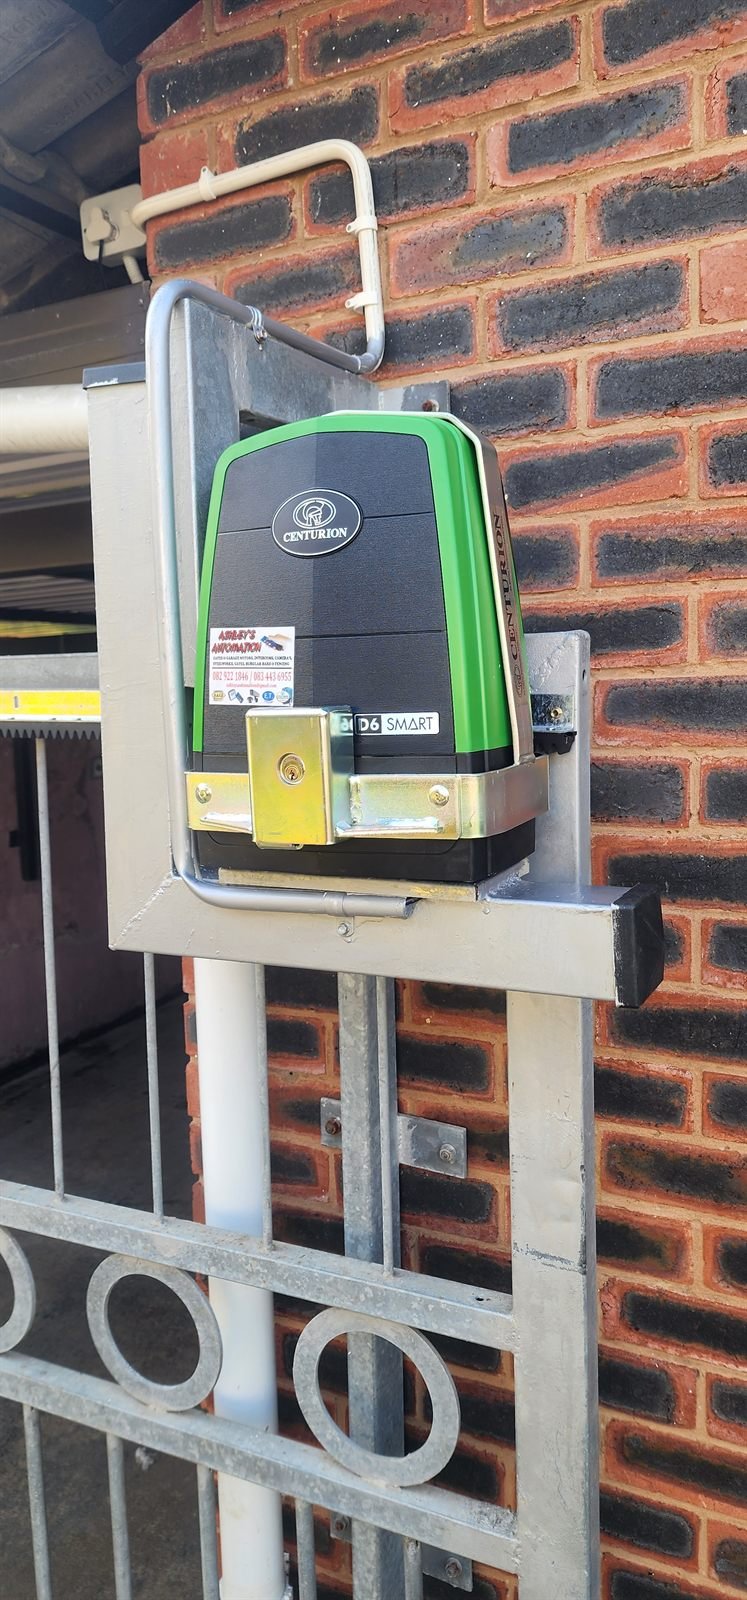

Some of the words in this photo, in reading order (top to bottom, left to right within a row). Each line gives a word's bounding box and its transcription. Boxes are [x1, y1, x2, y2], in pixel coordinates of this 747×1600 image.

[283, 527, 347, 542] CENTURION
[494, 513, 518, 660] CENTURION
[218, 630, 256, 640] ASHLEY'S
[212, 642, 262, 654] AUTOMATION
[212, 671, 222, 680] 082
[224, 671, 234, 681] 922
[235, 671, 248, 681] 1846
[254, 672, 264, 681] 083
[265, 672, 276, 681] 443
[277, 672, 292, 682] 6955
[359, 718, 380, 731] D6
[387, 716, 433, 731] SMART
